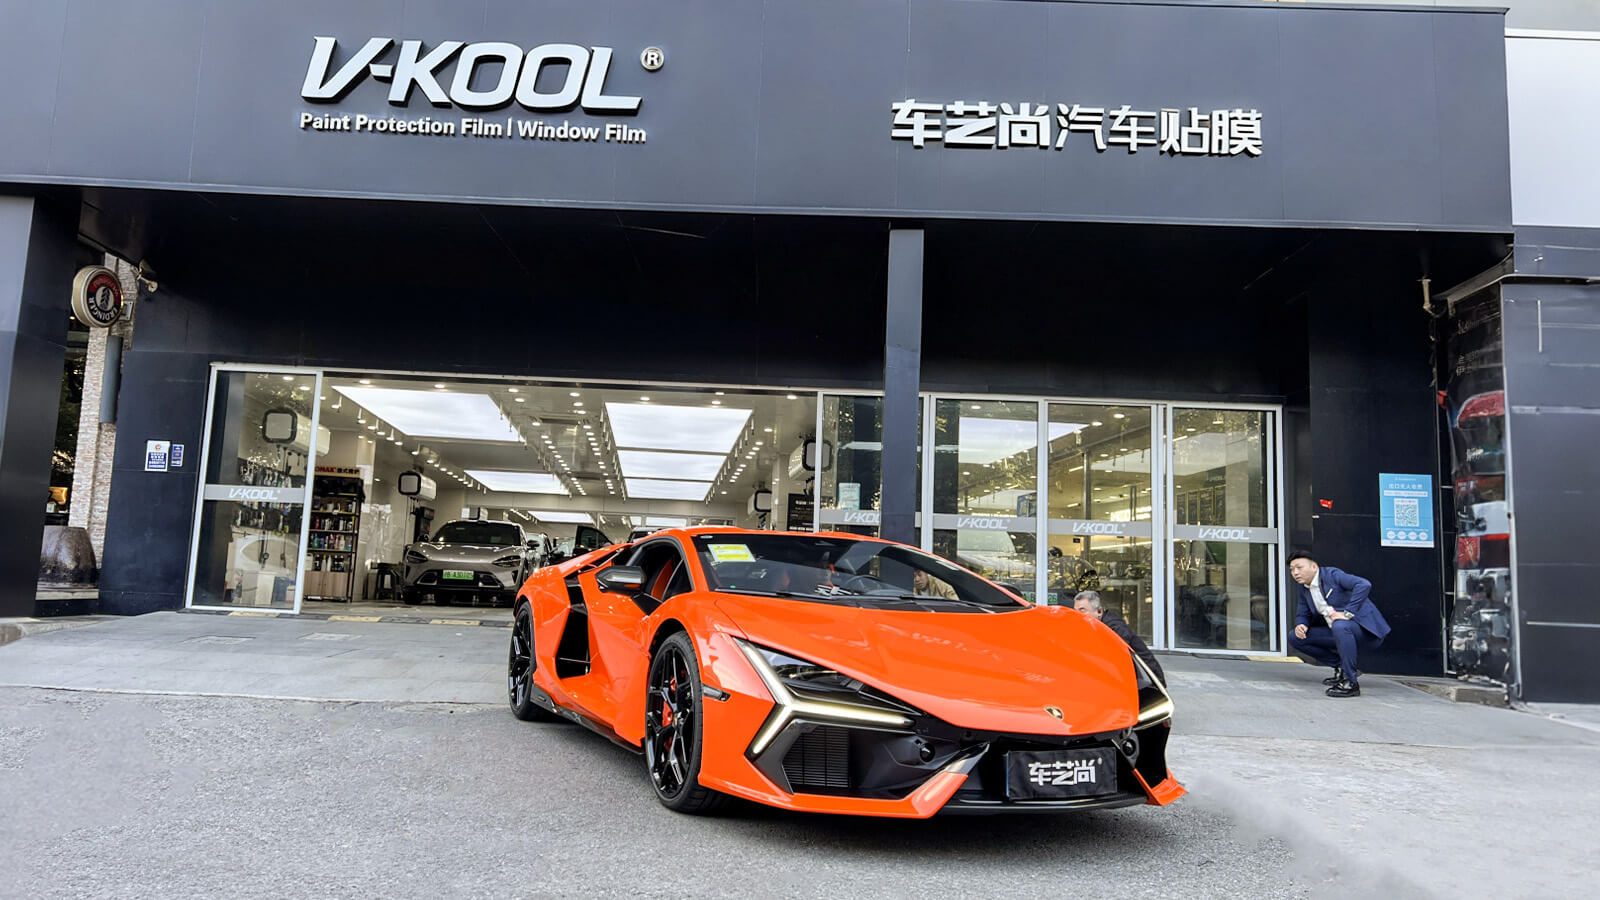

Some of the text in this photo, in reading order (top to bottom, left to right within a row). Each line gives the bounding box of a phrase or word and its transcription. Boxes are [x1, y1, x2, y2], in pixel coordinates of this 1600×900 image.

[301, 37, 643, 111] V-KOOL
[300, 112, 351, 131] Paint
[355, 113, 456, 135] Protection
[461, 118, 503, 137] Film
[517, 120, 600, 141] Window
[605, 123, 647, 143] Film
[891, 99, 1263, 156] 车艺尚汽车贴膜
[228, 487, 278, 501] V-KOOL
[957, 517, 1009, 530] V-KOOL
[1072, 521, 1124, 535] V-KOOL
[1198, 527, 1250, 541] V-KOOL
[1028, 759, 1096, 786] 车艺尚
